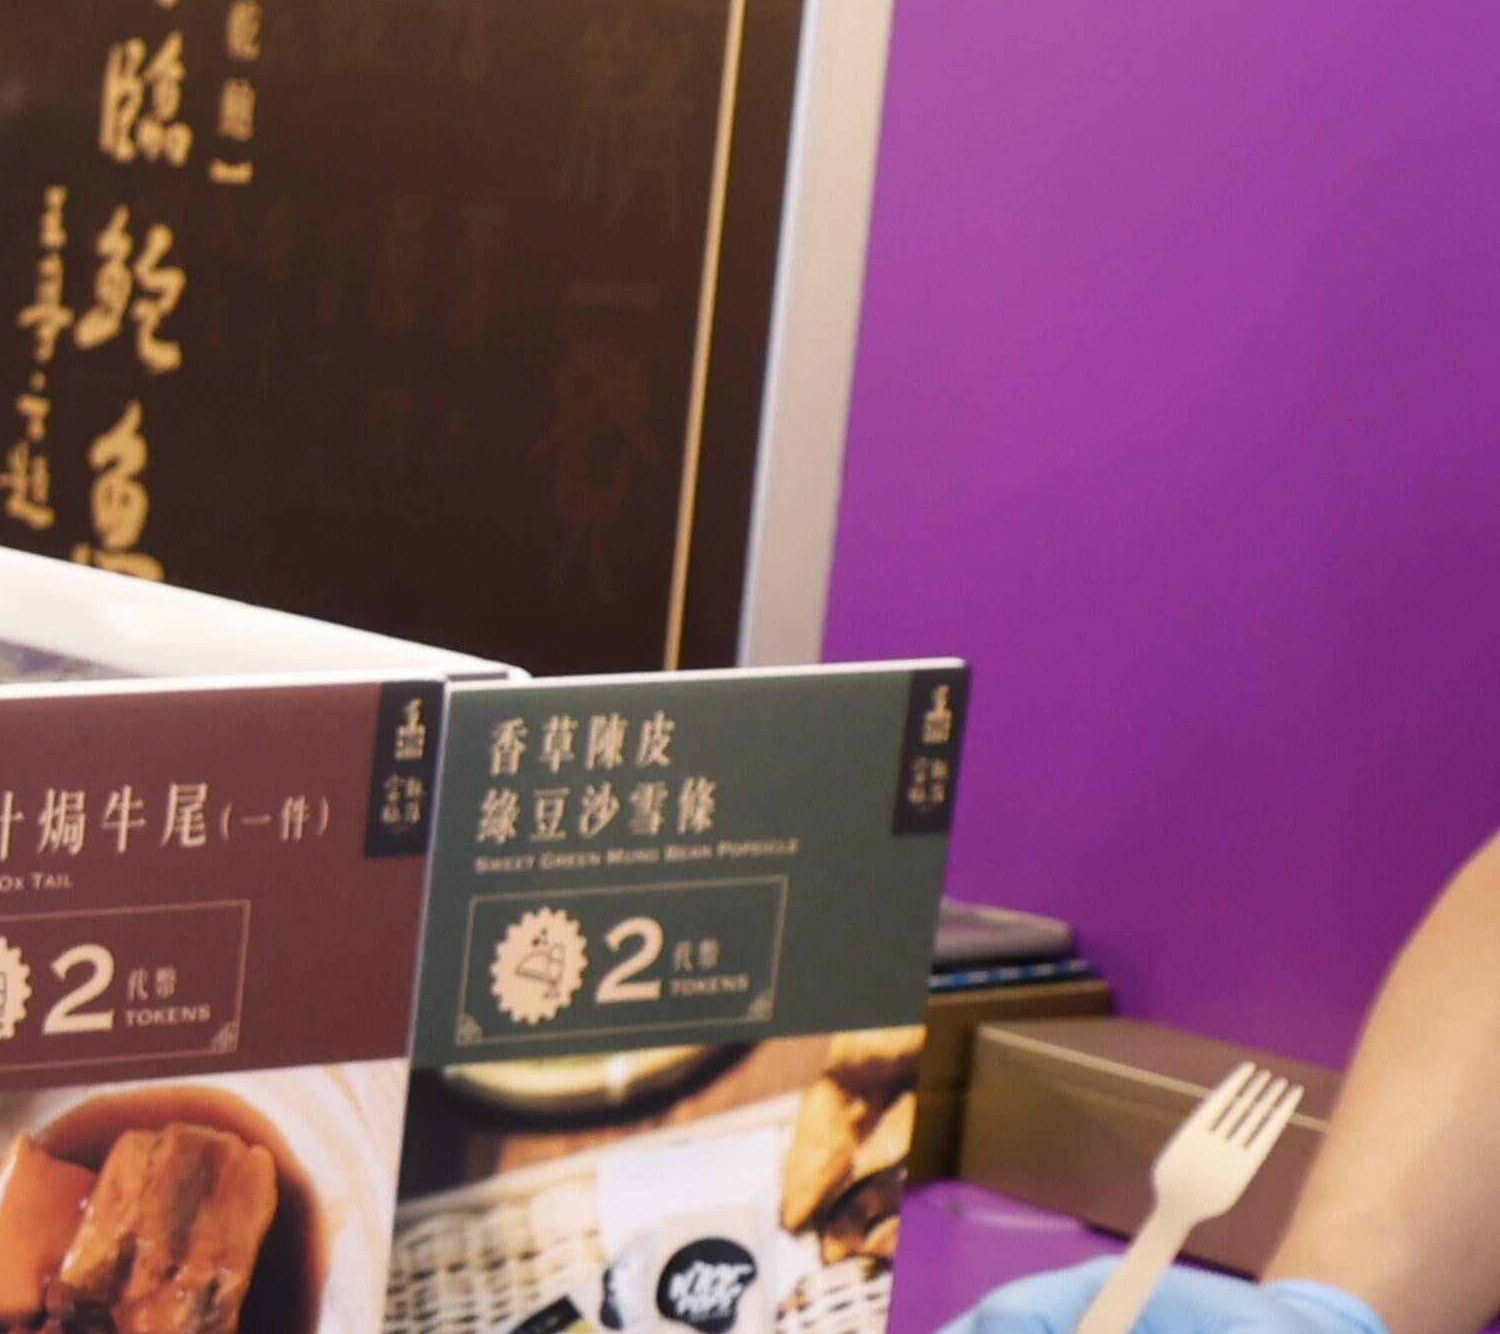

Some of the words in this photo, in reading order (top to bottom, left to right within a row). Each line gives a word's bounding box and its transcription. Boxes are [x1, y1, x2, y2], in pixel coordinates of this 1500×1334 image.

[41, 943, 115, 1035] 2
[594, 916, 665, 1004] 2
[124, 1003, 211, 1027] TOKENS
